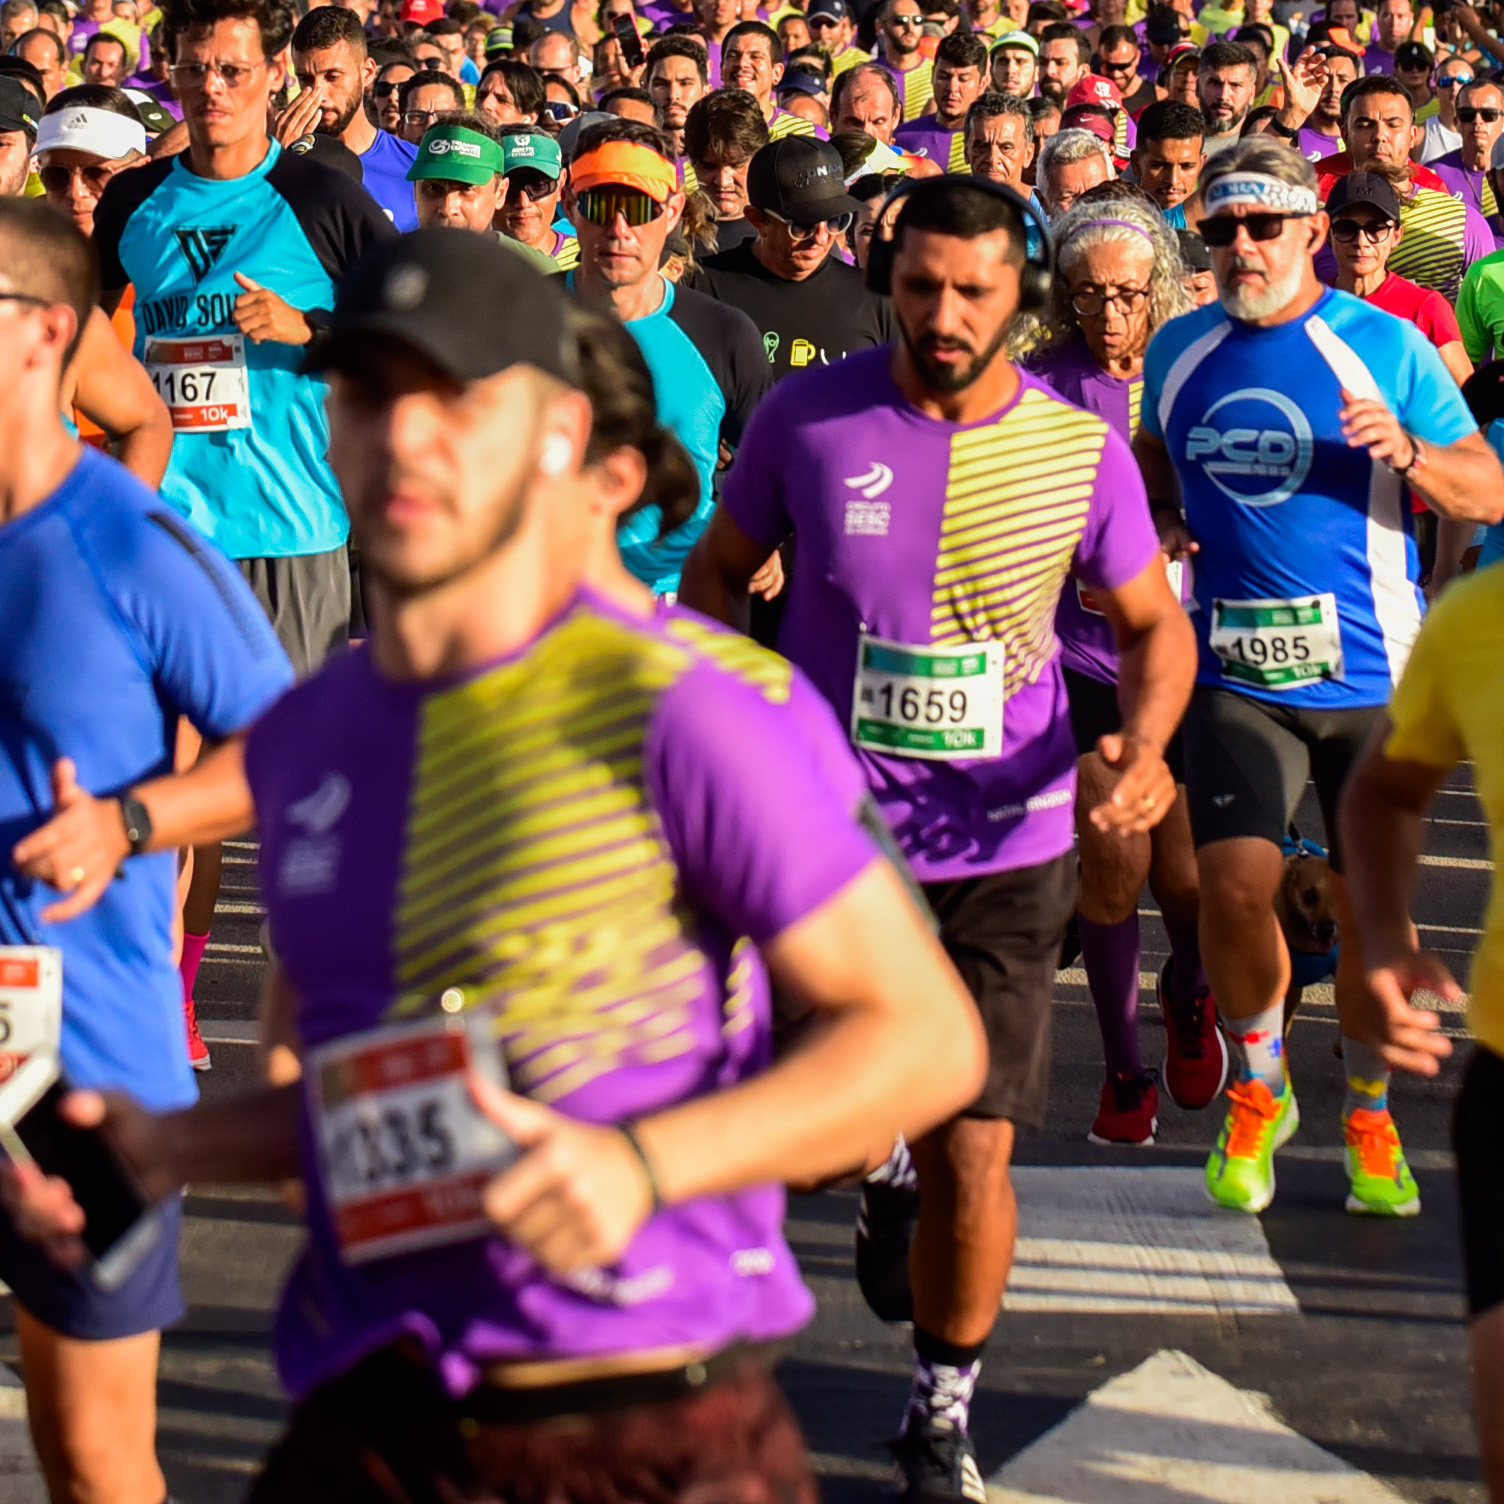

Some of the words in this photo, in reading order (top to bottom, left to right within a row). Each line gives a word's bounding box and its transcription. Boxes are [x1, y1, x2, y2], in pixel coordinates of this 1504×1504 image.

[197, 293, 240, 328] SOU
[200, 407, 229, 421] 10k
[1186, 426, 1295, 464] PCD
[1232, 636, 1310, 666] 1985
[880, 683, 967, 723] 1659
